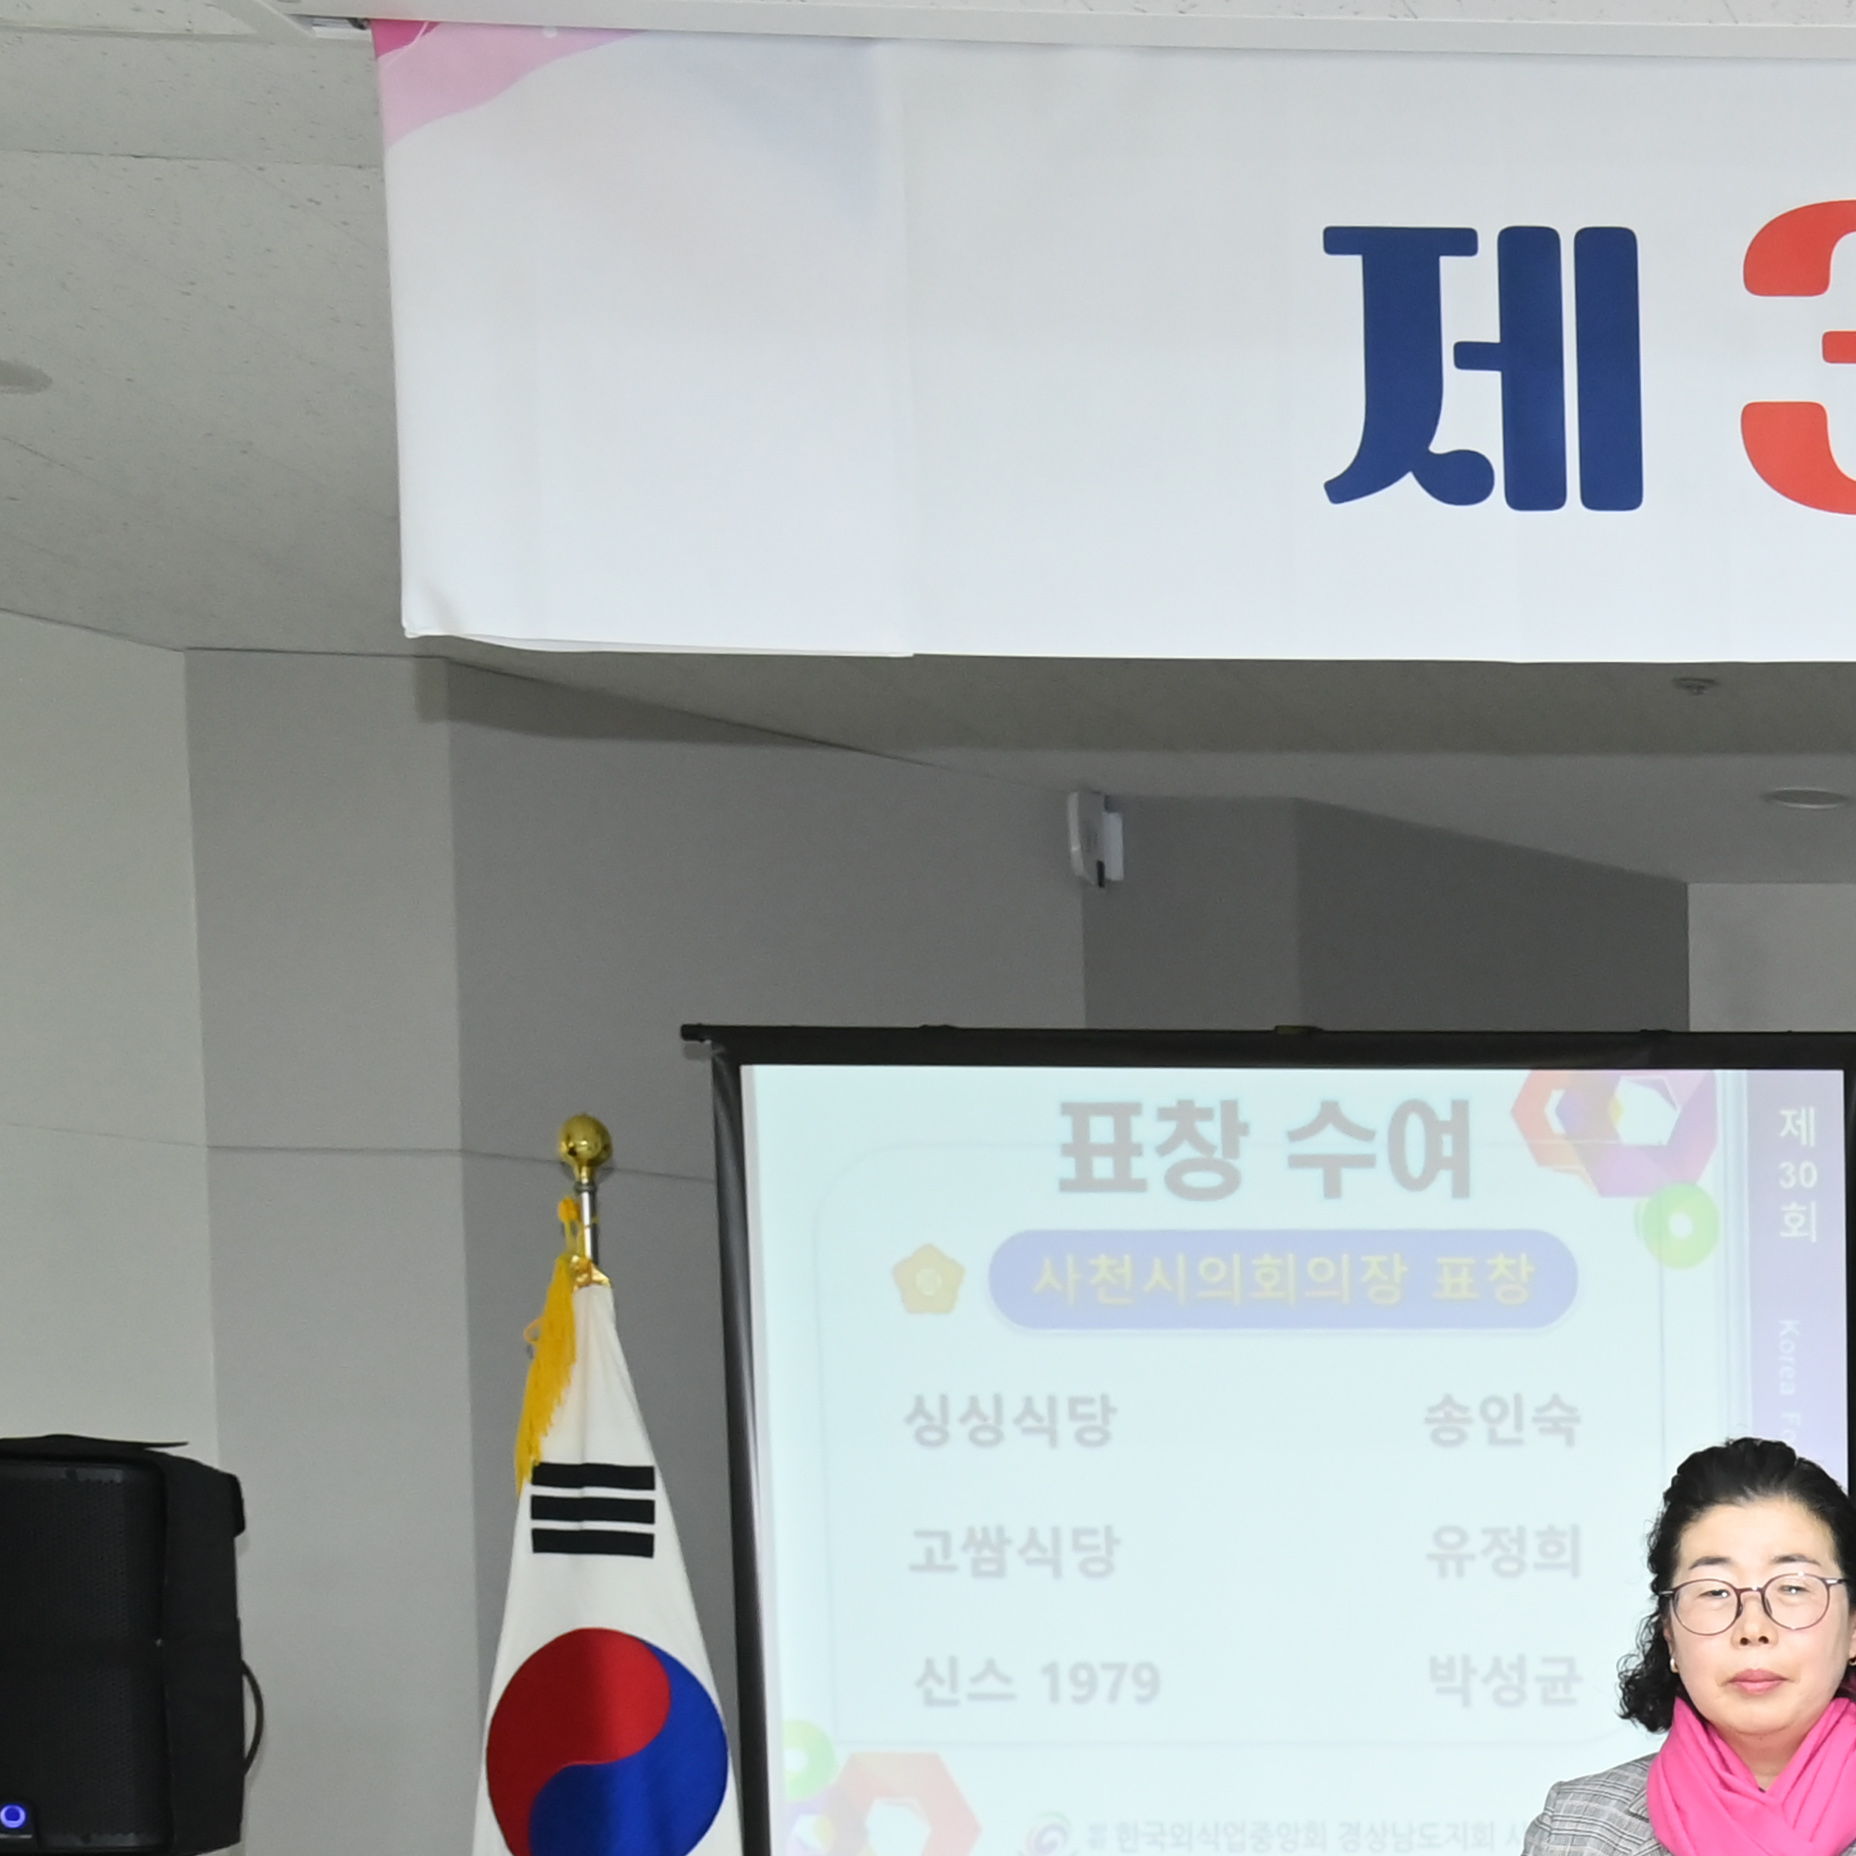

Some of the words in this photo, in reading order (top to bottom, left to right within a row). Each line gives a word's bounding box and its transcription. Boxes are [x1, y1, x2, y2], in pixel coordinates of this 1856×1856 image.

[1059, 1099, 1250, 1202] 표창
[1287, 1099, 1471, 1200] 수여
[1032, 1253, 1408, 1307] 사천시의회의장
[1432, 1253, 1536, 1306] 표창
[1778, 1319, 1801, 1396] Korea
[903, 1393, 1119, 1449] 싱싱식당
[1424, 1392, 1582, 1448] 송인숙
[908, 1524, 1122, 1580] 고쌈식당
[1425, 1524, 1582, 1579] 유정희
[914, 1656, 1017, 1707] 신스
[1041, 1661, 1162, 1704] 1979
[1428, 1654, 1584, 1709] 박성균
[1115, 1820, 1328, 1854] 한국외식업중앙회
[1338, 1820, 1496, 1853] 경상남도지회
